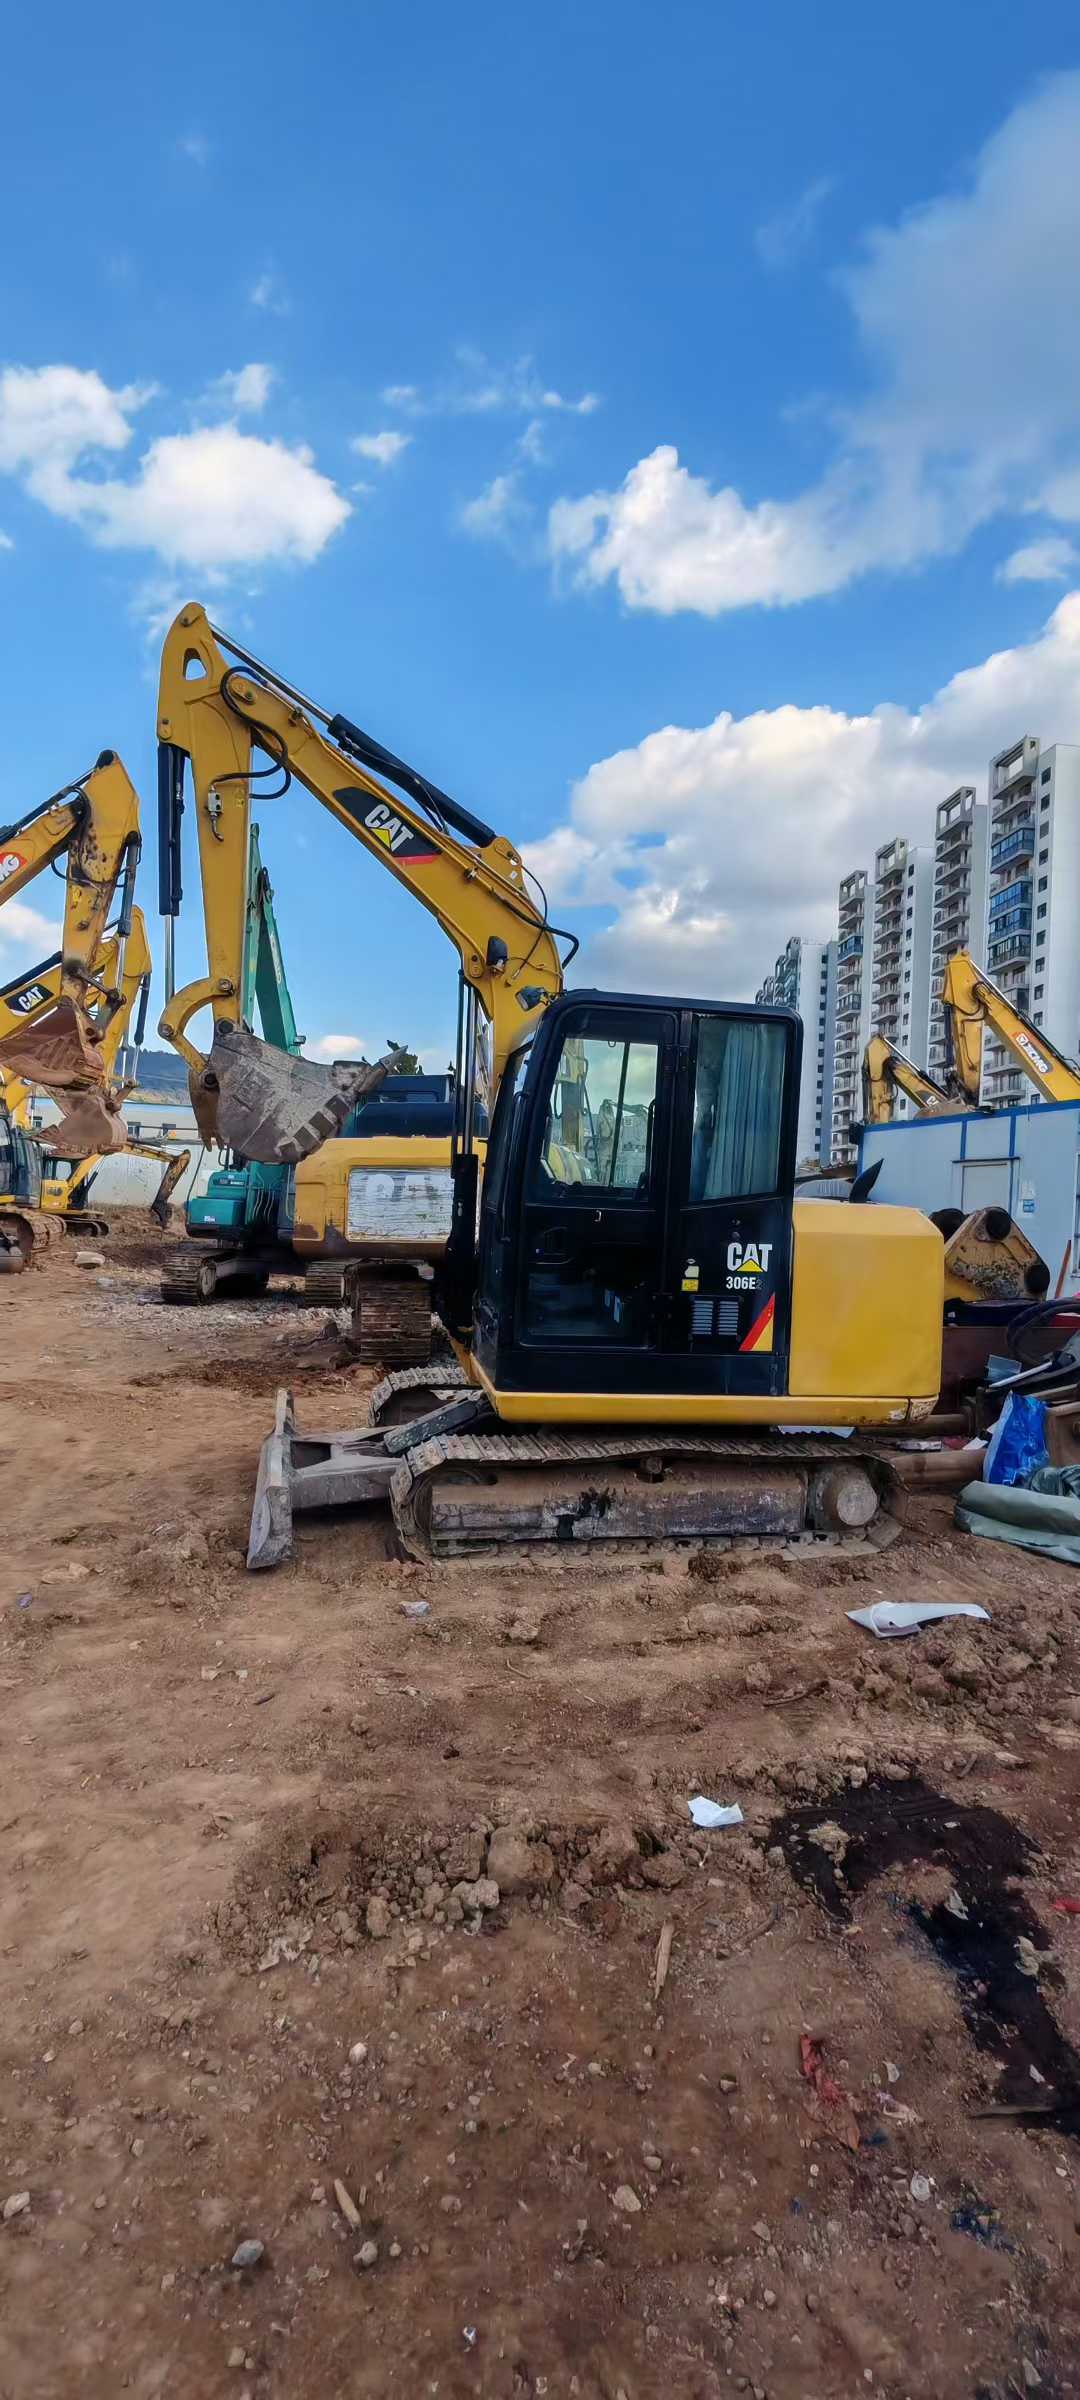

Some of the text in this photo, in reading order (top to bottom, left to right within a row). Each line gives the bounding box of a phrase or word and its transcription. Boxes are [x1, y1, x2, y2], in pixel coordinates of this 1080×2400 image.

[364, 804, 414, 852] CAT
[18, 986, 44, 1011] CAT
[726, 1242, 773, 1272] CAT
